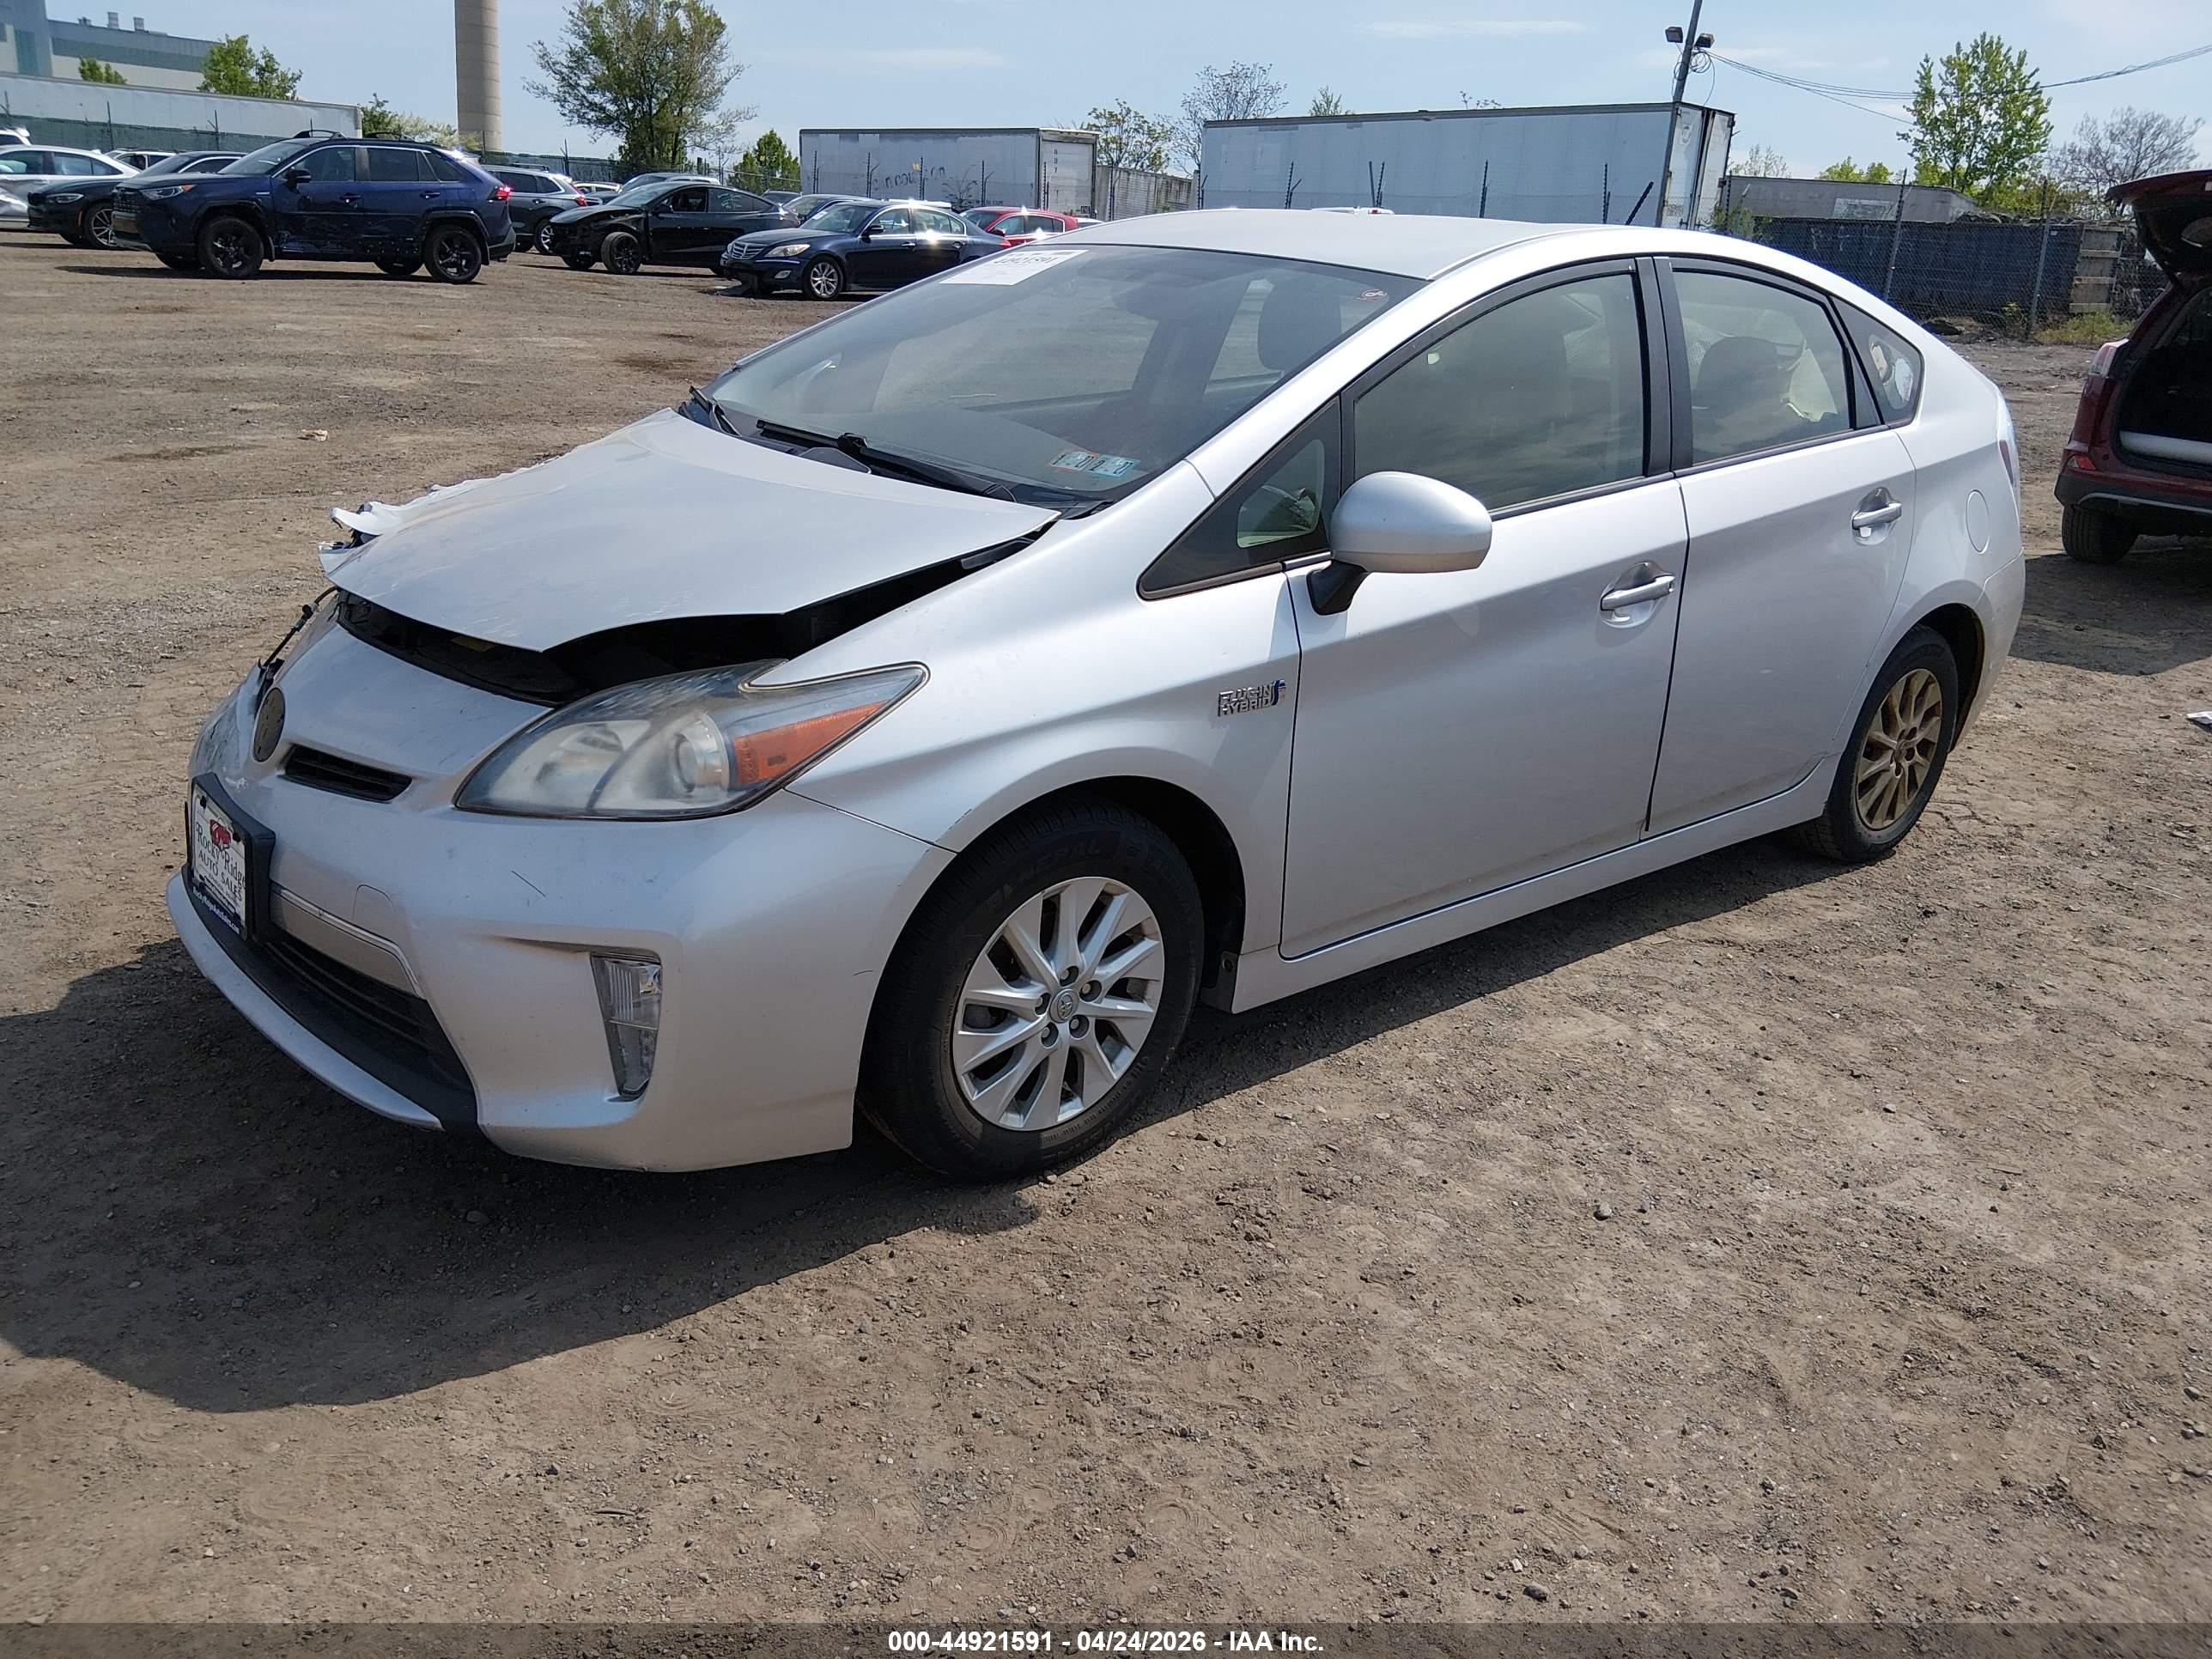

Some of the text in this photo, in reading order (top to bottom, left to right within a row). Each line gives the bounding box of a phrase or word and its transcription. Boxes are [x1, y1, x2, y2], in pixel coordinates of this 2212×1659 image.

[198, 849, 219, 877] AUTO
[221, 872, 243, 902] SALES
[220, 850, 246, 890] Ridge
